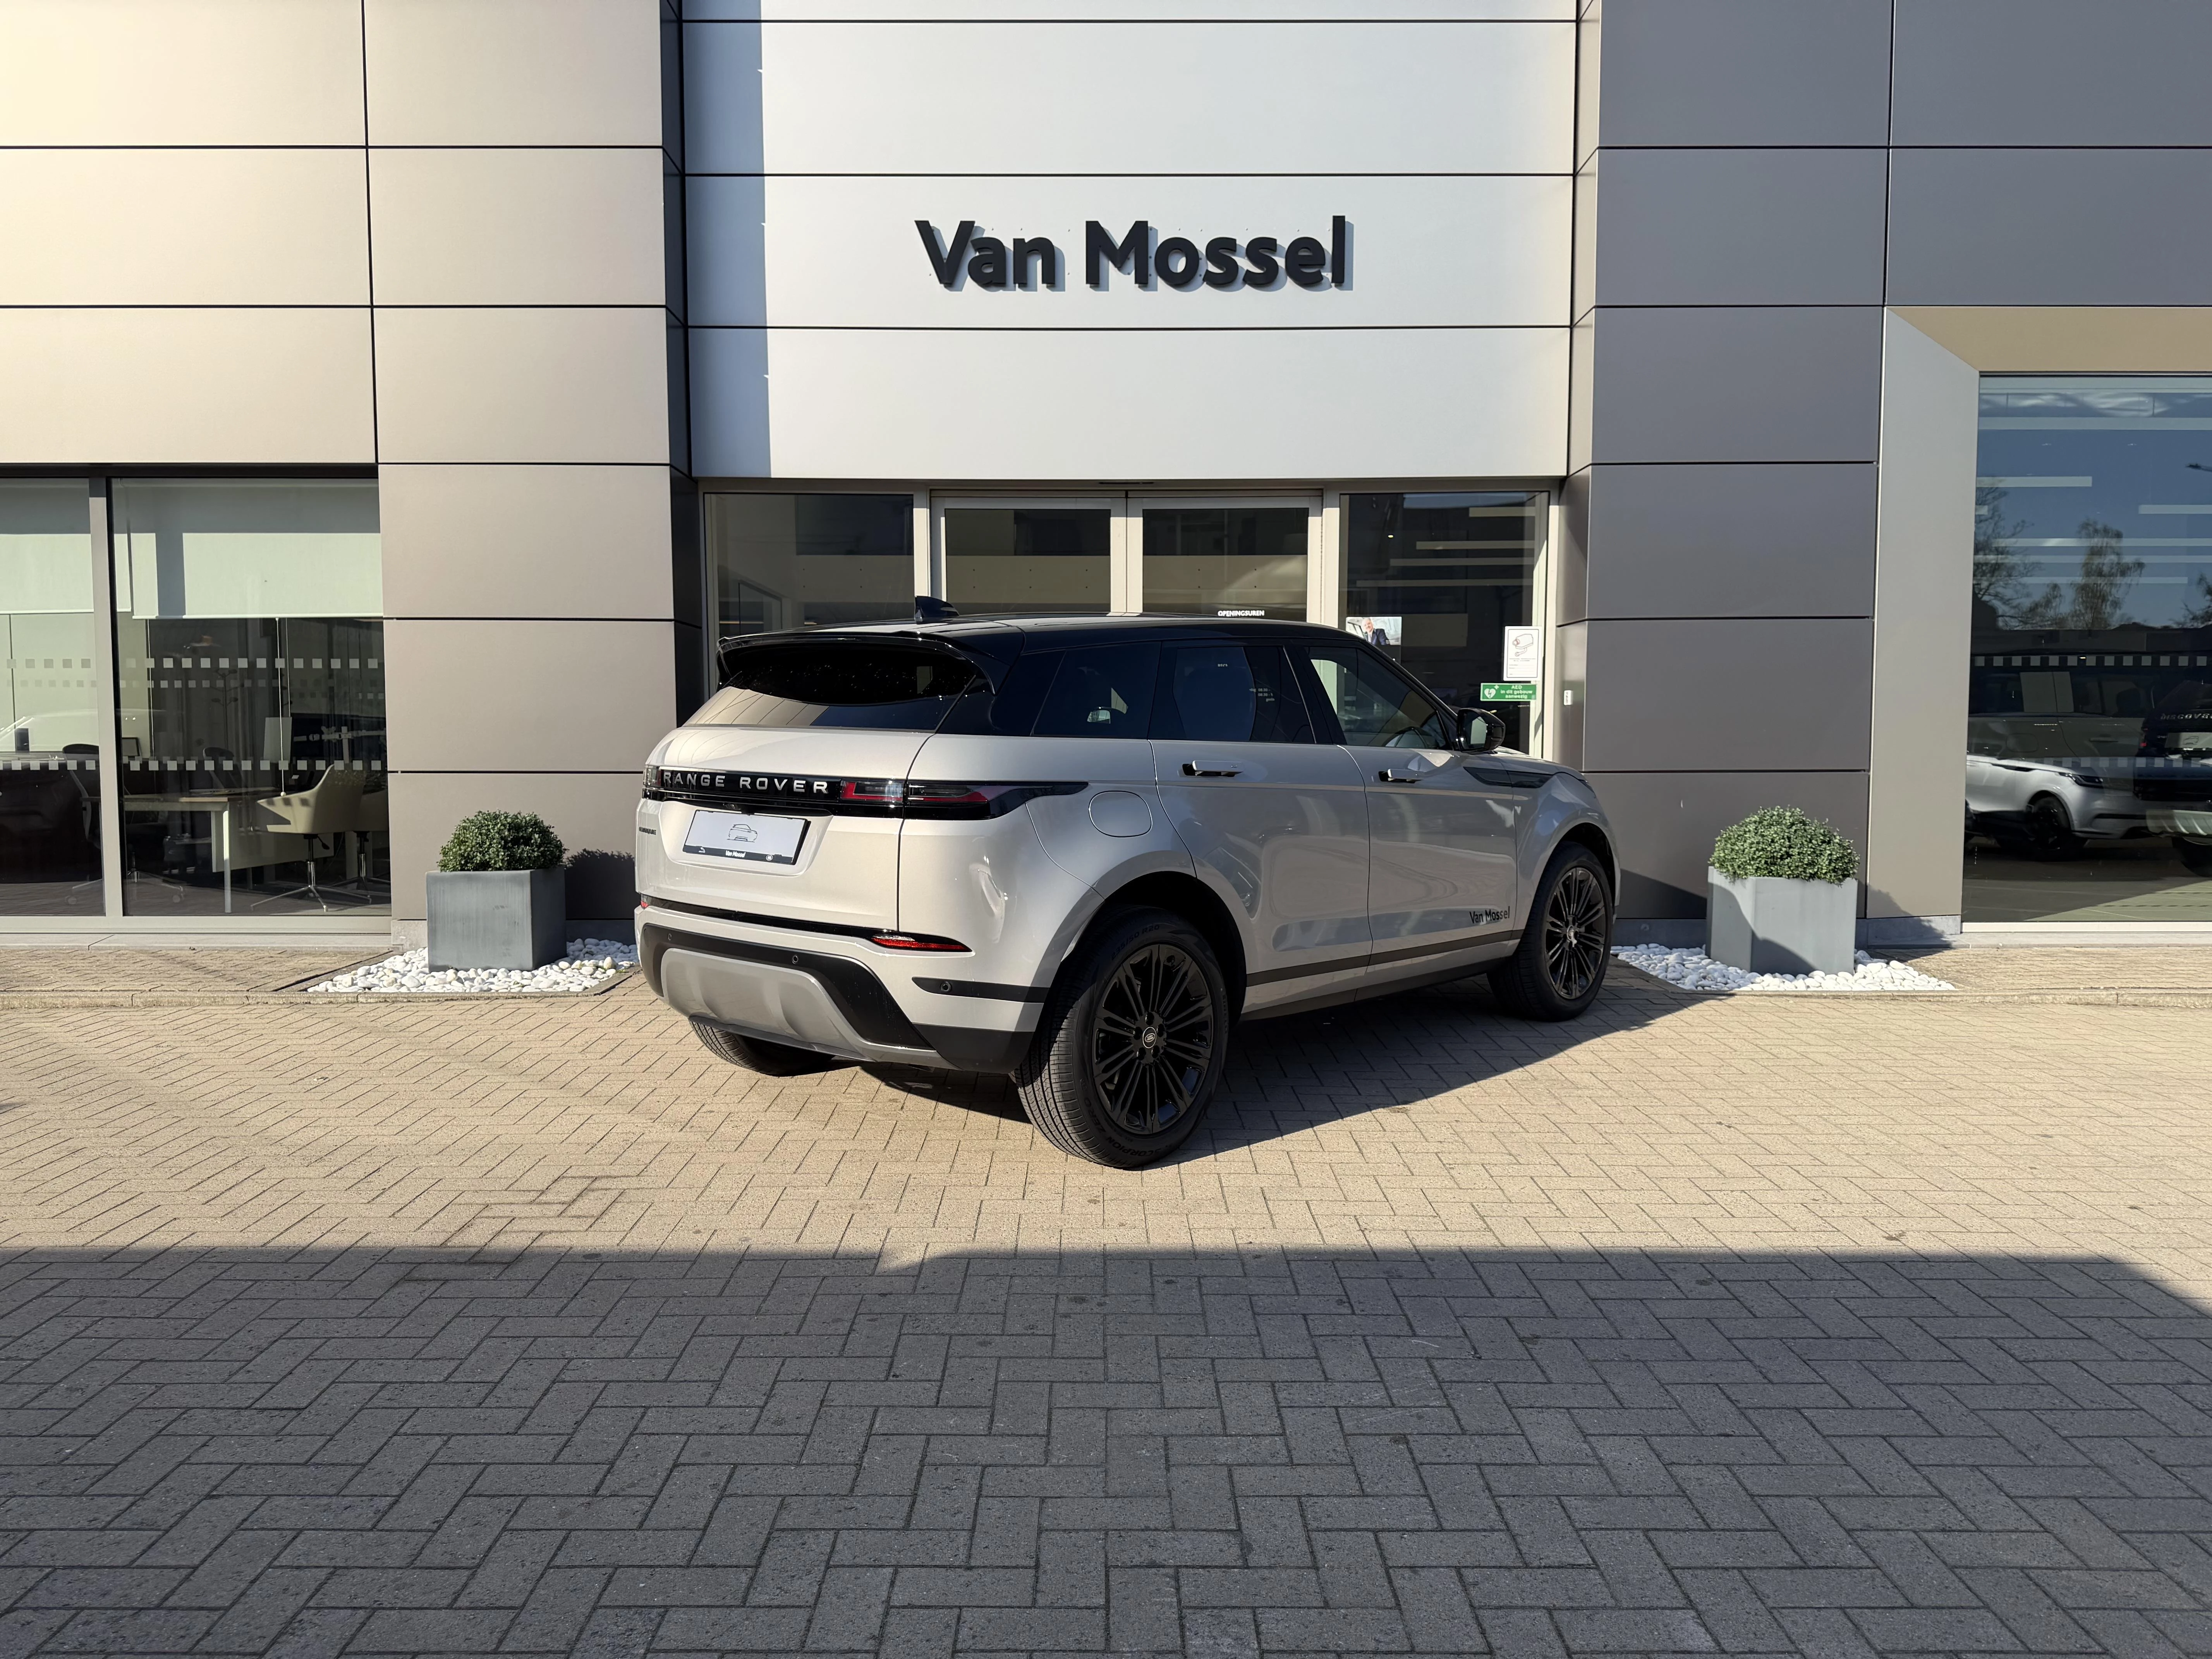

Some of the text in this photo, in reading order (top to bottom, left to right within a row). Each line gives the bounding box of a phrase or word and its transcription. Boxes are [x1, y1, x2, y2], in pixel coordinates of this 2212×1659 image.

[914, 215, 1346, 286] Van Mossel
[663, 772, 828, 794] RANGE ROVER
[1469, 906, 1510, 924] Van Mossel
